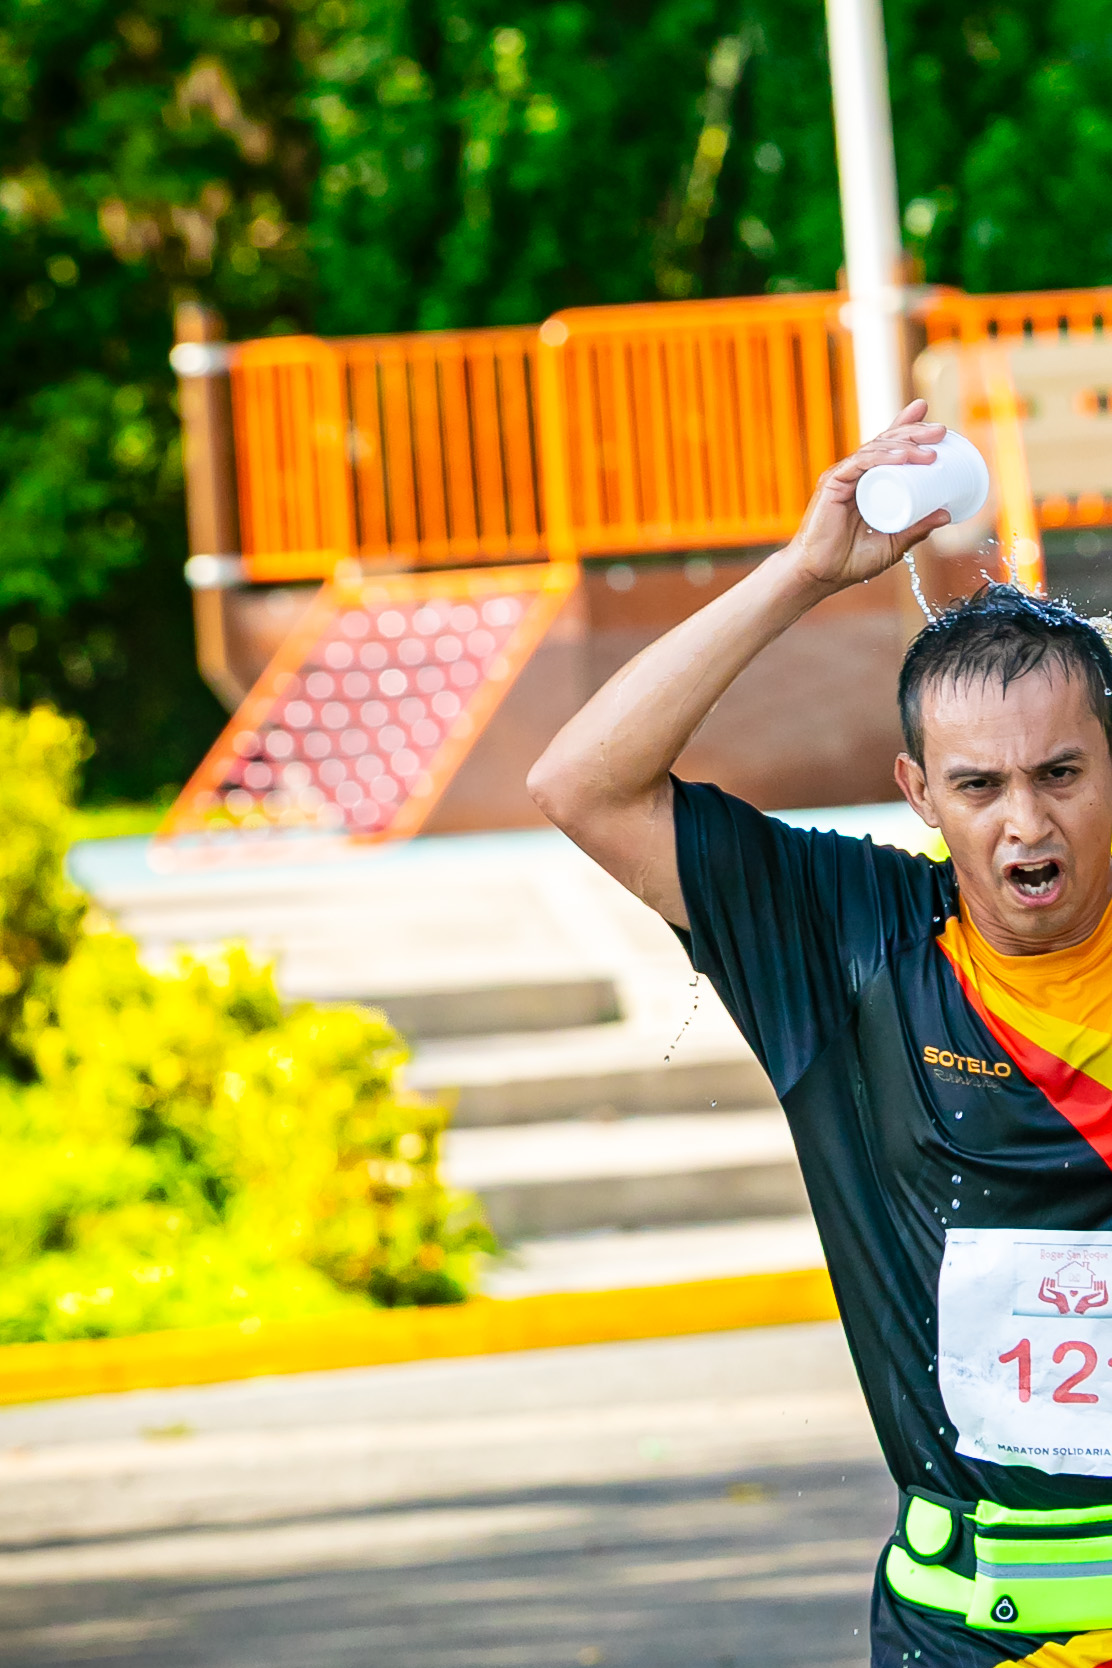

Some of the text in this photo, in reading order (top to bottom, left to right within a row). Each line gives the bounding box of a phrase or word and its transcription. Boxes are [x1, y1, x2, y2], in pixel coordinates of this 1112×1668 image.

[923, 1045, 1011, 1077] SOTELO
[997, 1443, 1050, 1456] MARATON
[1052, 1447, 1111, 1457] SOLIDARIA
